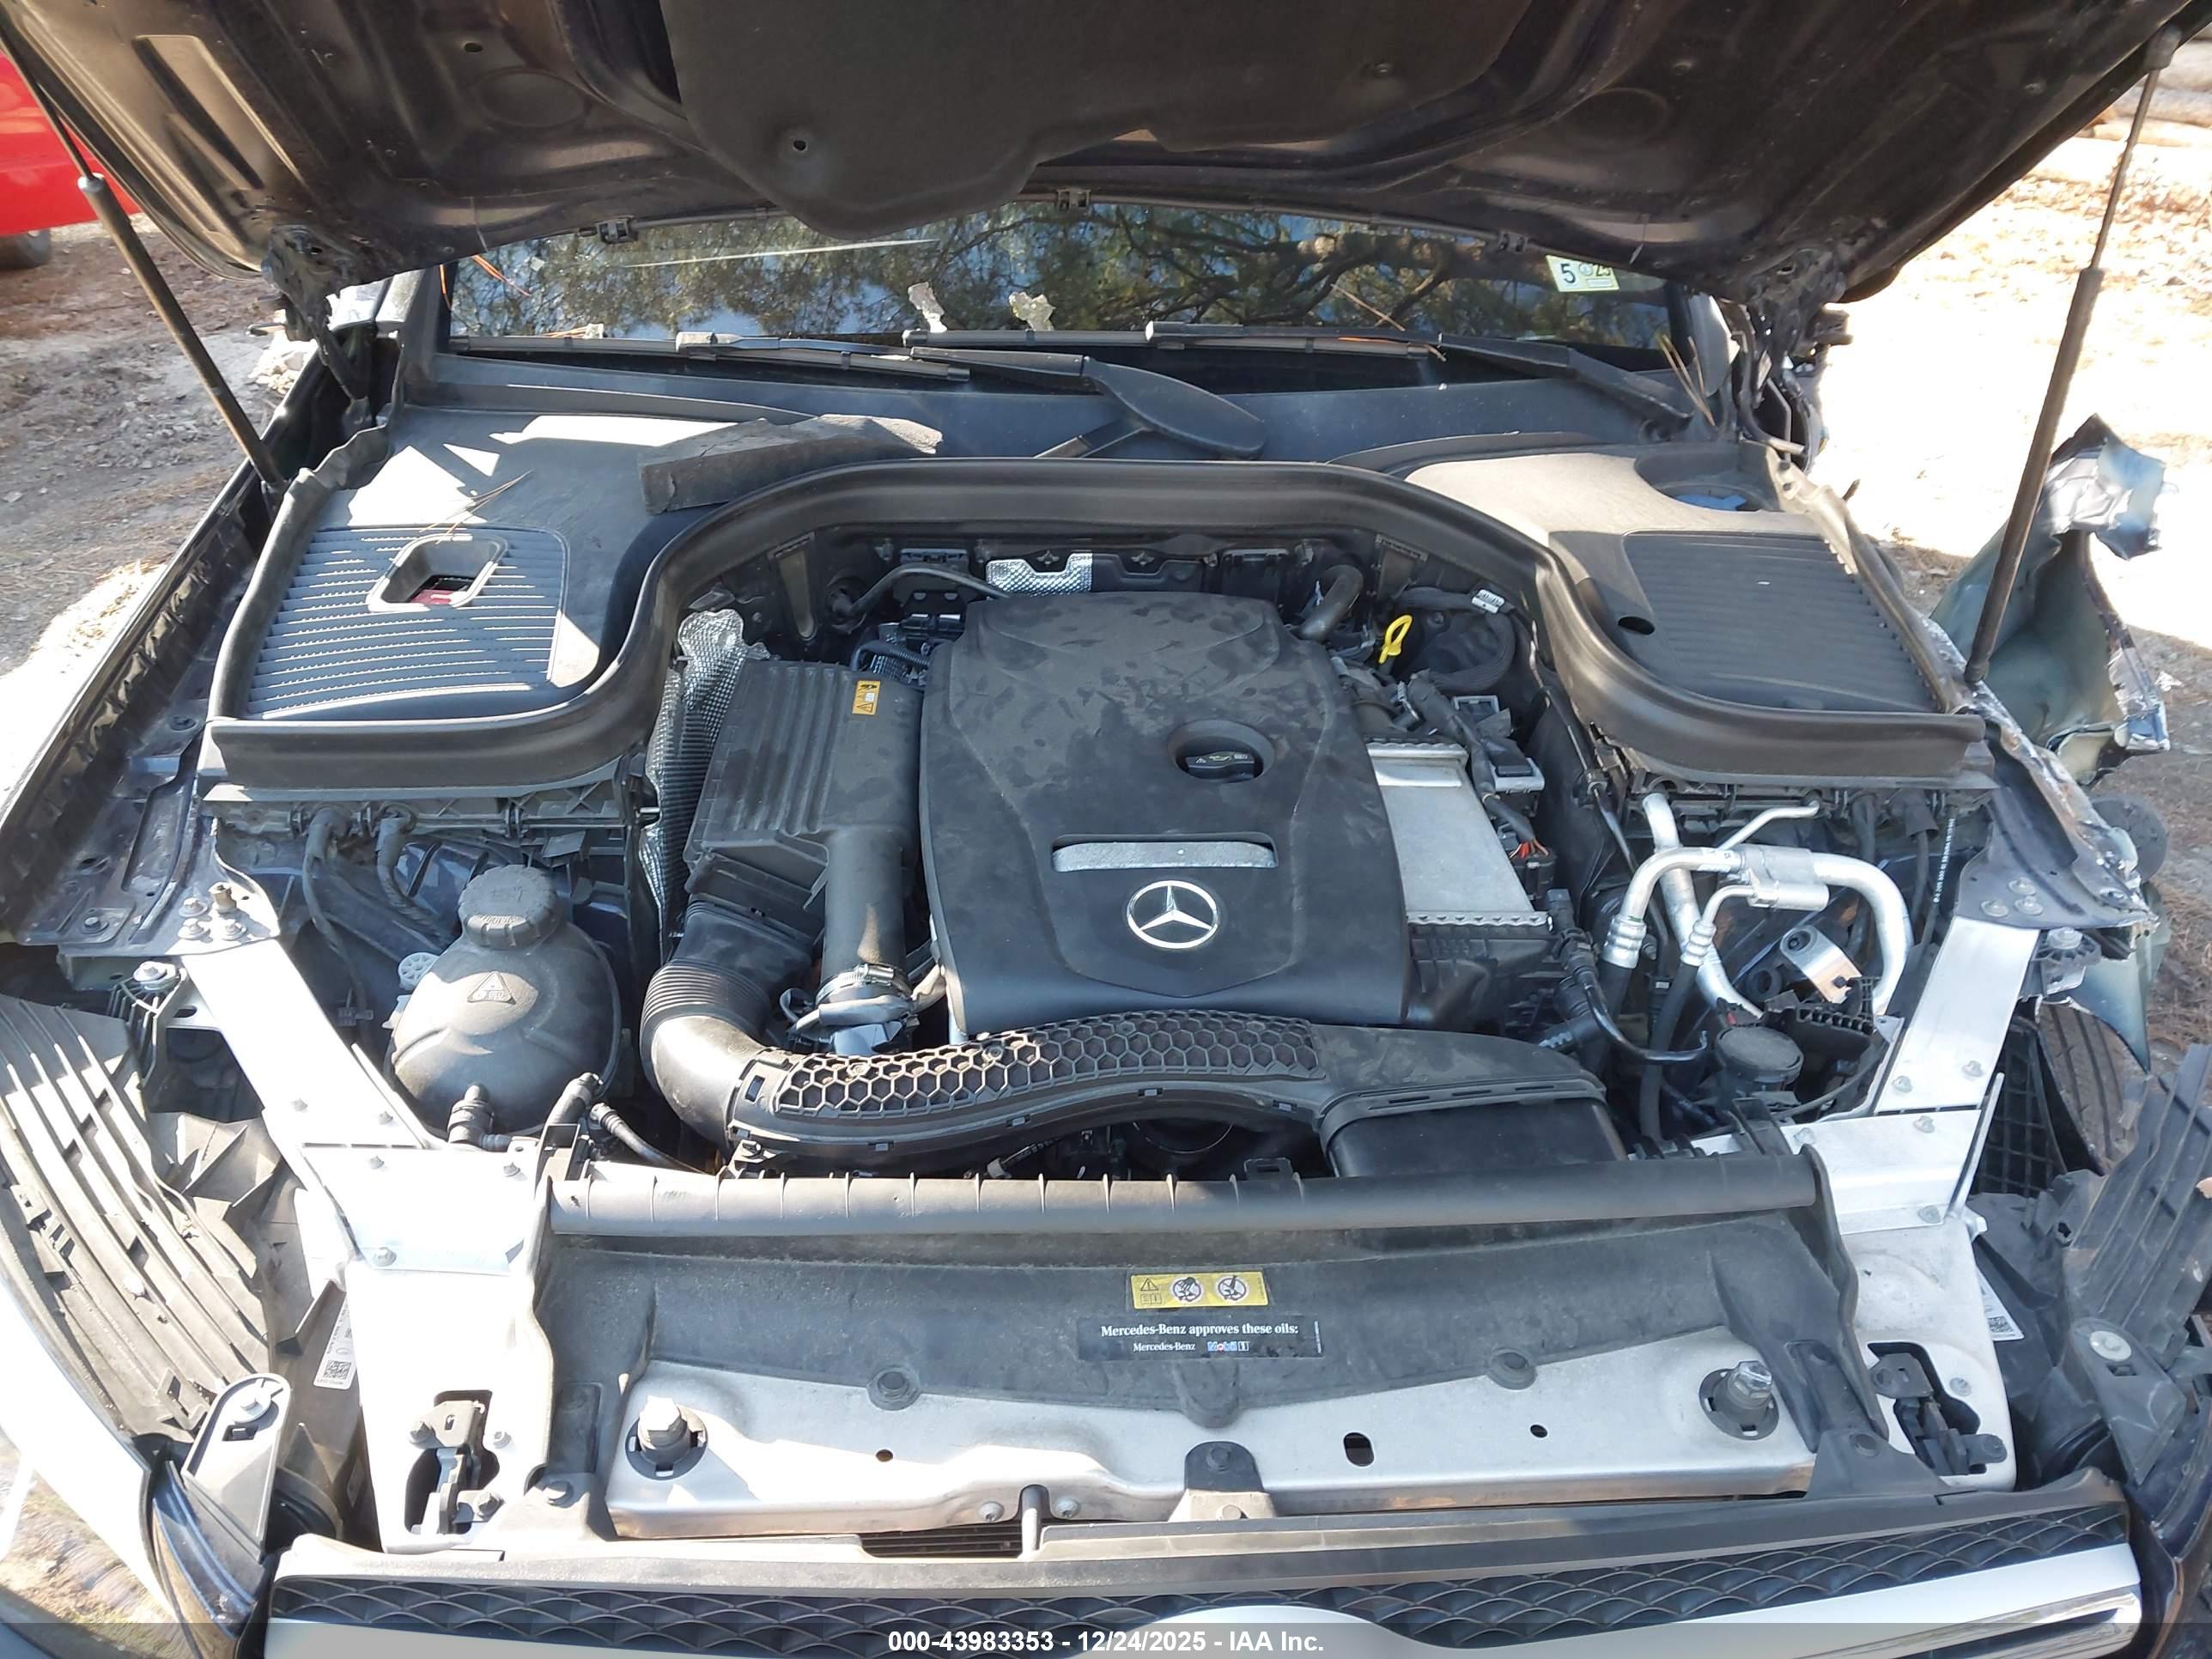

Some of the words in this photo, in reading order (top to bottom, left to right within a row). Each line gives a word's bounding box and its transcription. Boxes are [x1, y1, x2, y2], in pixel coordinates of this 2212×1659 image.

[1560, 264, 1576, 284] 5
[1100, 1324, 1187, 1337] Mercedes-Benz
[1188, 1325, 1240, 1338] approves
[1242, 1323, 1273, 1335] these
[1274, 1323, 1299, 1334] oils:
[1133, 1341, 1196, 1352] Mercedes-Benz
